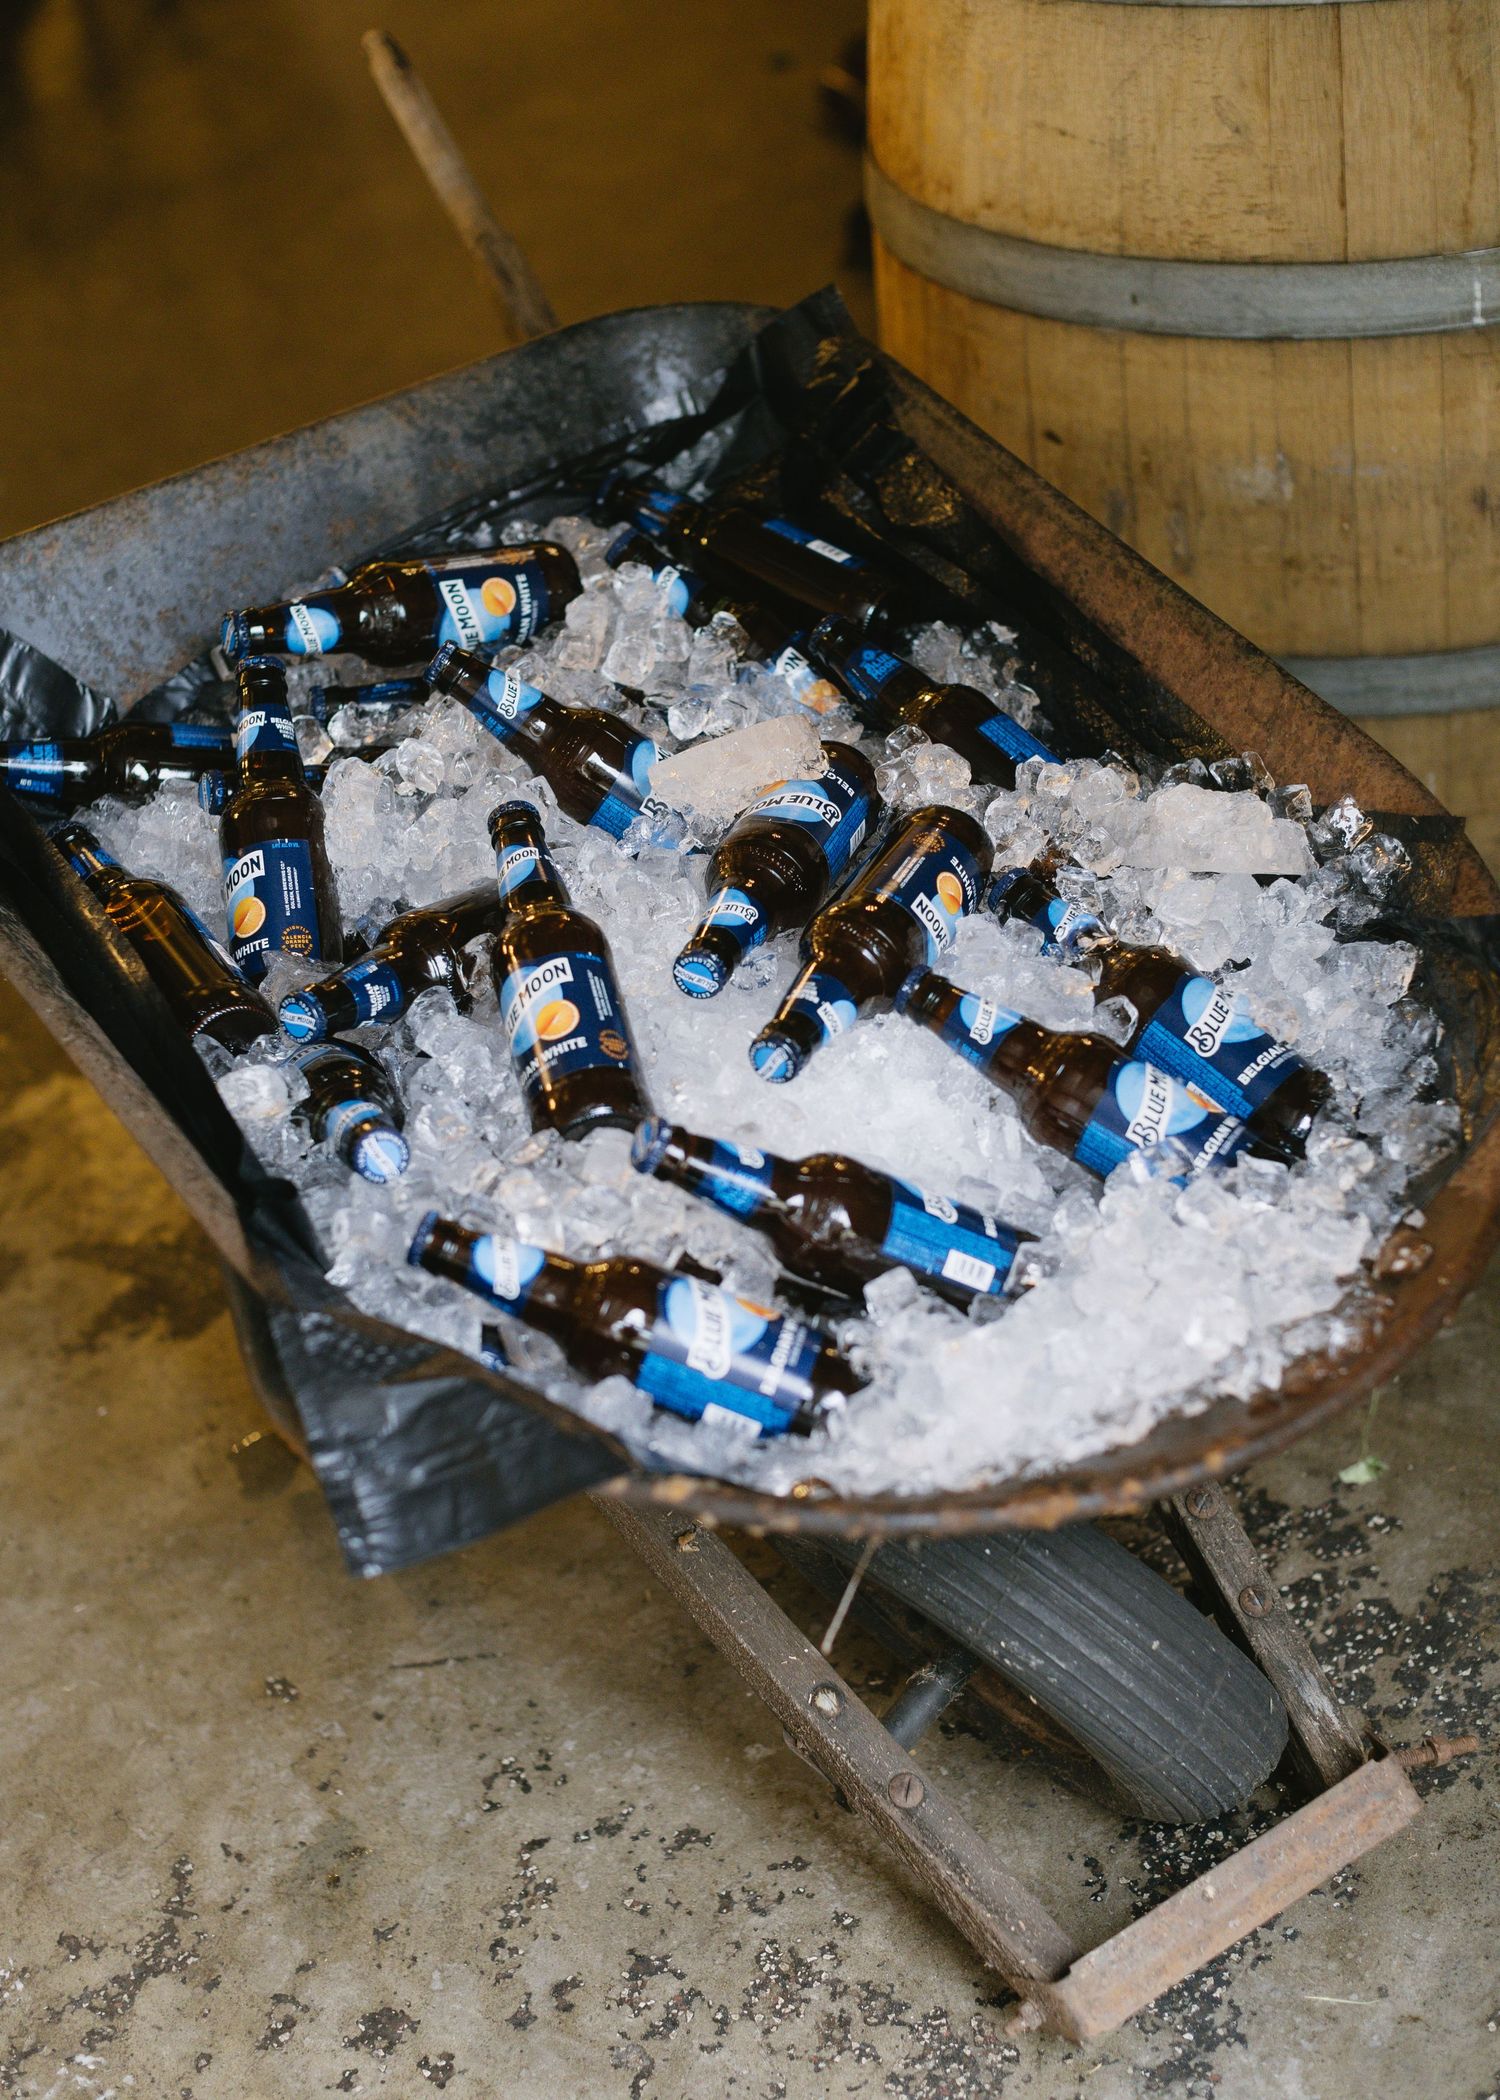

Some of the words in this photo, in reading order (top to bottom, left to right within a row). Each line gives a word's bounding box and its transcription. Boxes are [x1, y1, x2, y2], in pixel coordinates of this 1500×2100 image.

[445, 582, 476, 630] MOON
[515, 573, 532, 616] WHITE
[500, 684, 517, 717] BLUE
[787, 795, 840, 821] BLUE
[226, 855, 261, 894] MOON
[506, 849, 537, 870] MOON
[950, 857, 973, 900] WHITE
[724, 904, 757, 921] BLUE
[916, 899, 946, 944] MOON
[235, 938, 270, 961] WHITE
[519, 963, 568, 1009] MOON
[973, 1008, 992, 1042] BLUE
[1190, 1001, 1229, 1053] BLUE
[541, 1036, 588, 1062] WHITE
[1132, 1088, 1167, 1147] BLUE
